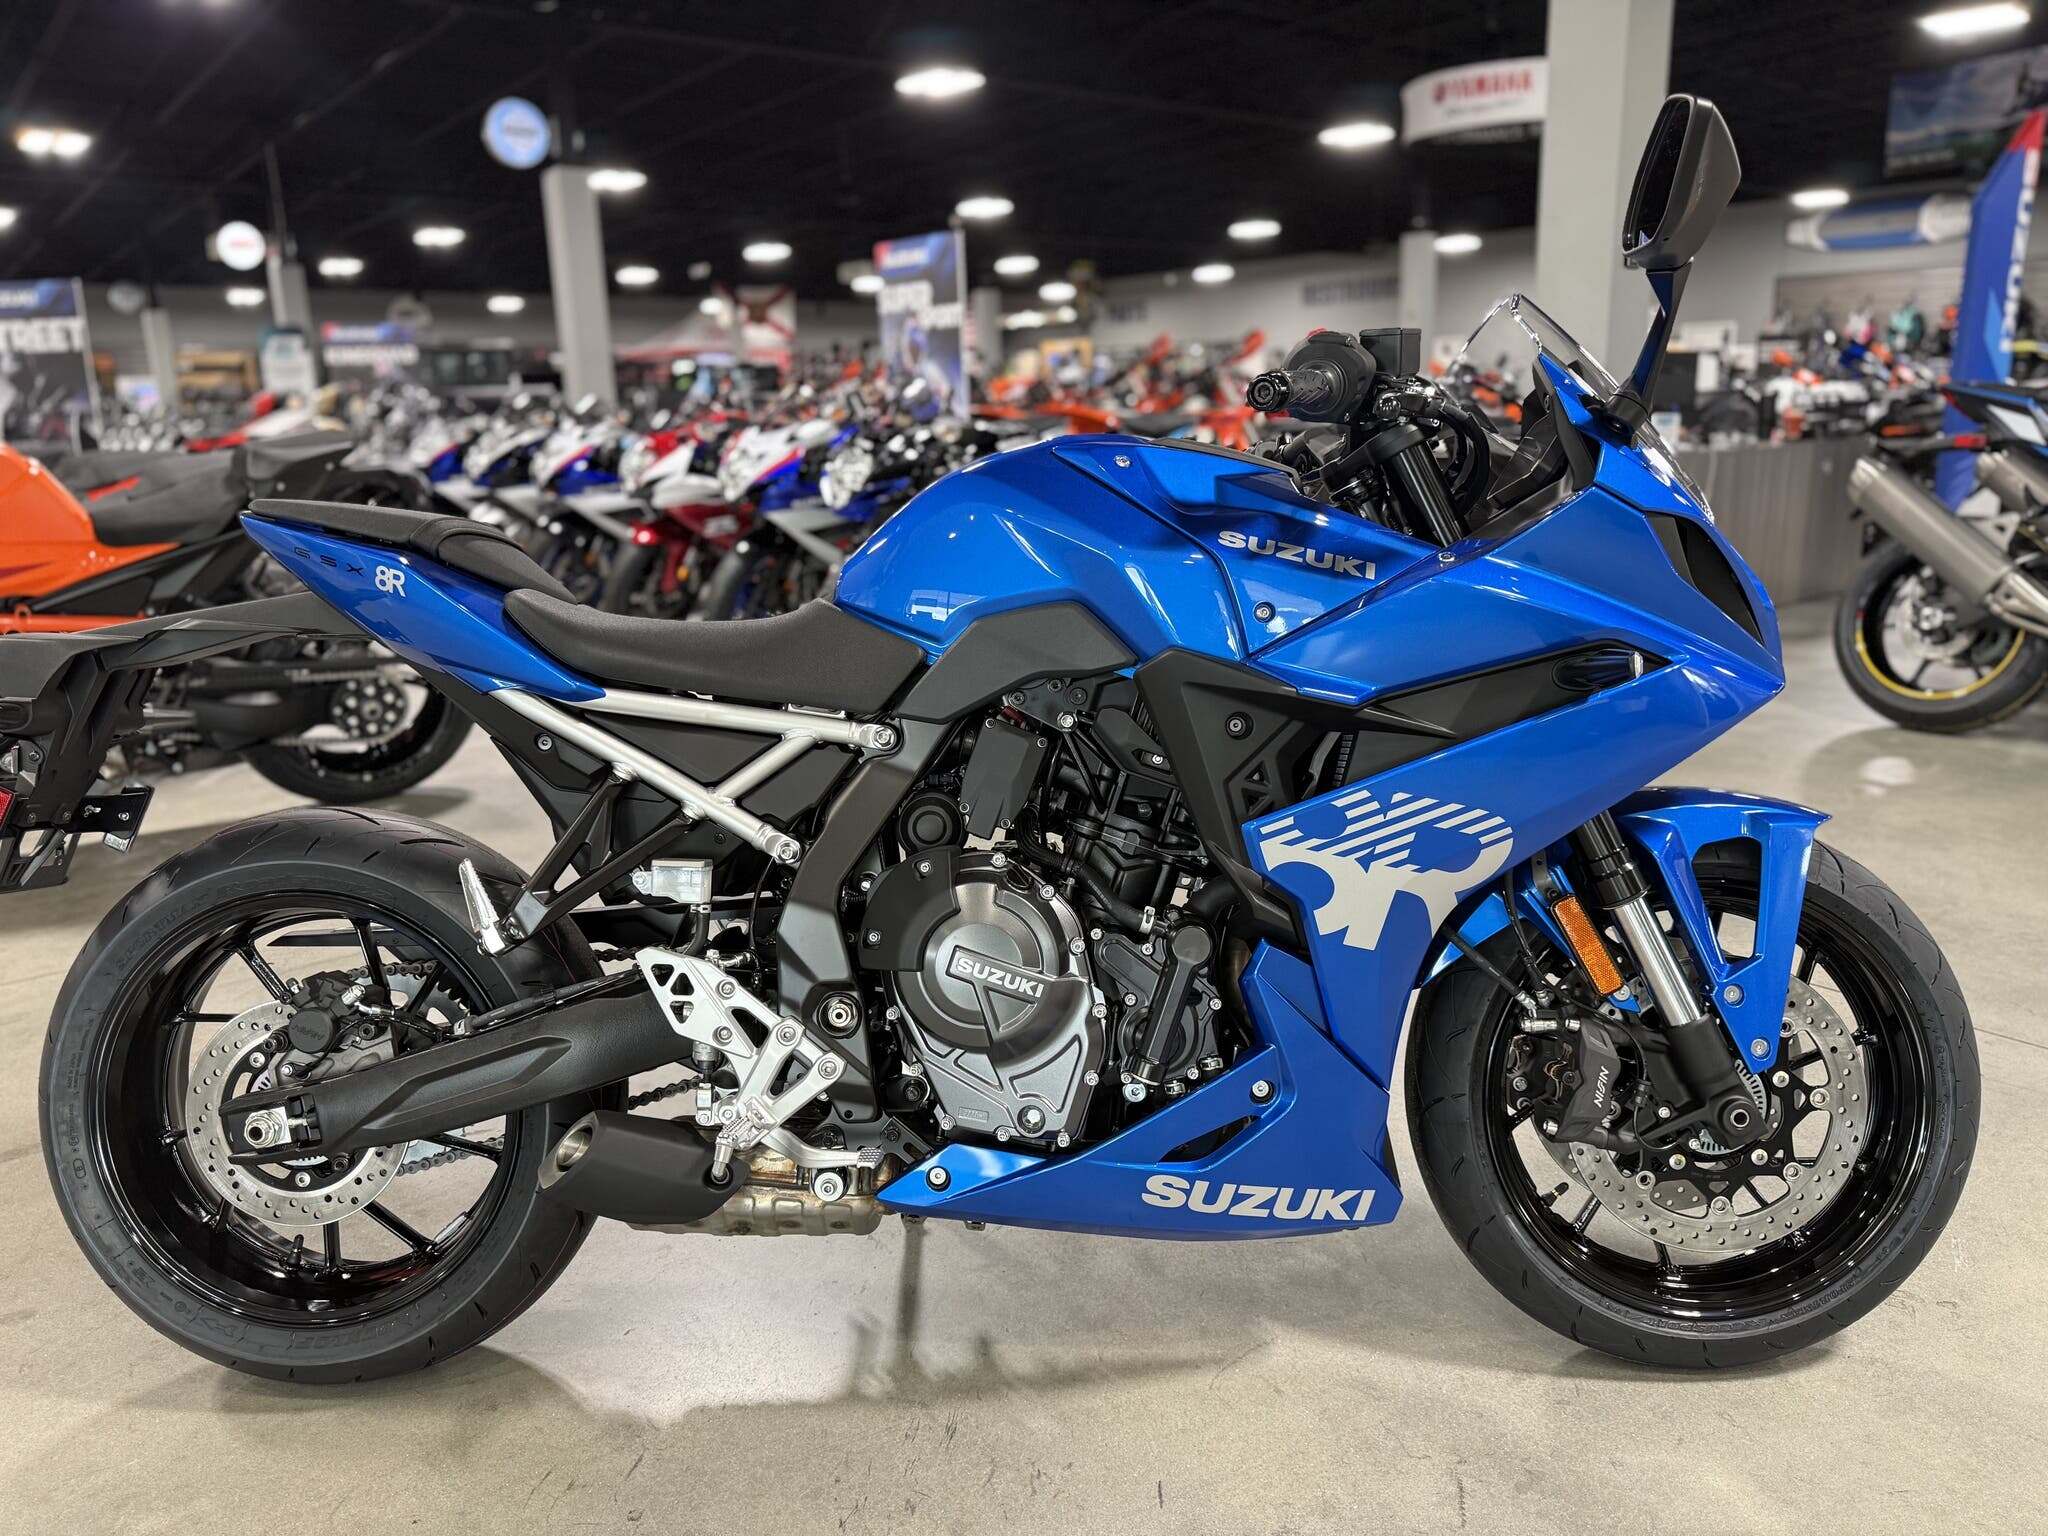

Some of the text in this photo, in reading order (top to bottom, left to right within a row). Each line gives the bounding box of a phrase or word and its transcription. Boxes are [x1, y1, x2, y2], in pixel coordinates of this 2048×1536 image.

[294, 546, 406, 598] GSX 8R
[1218, 530, 1376, 580] SUZUKI
[957, 957, 1044, 998] SUZUKI
[1593, 1065, 1609, 1109] NISSIN
[1141, 1174, 1376, 1221] SUZUKI
